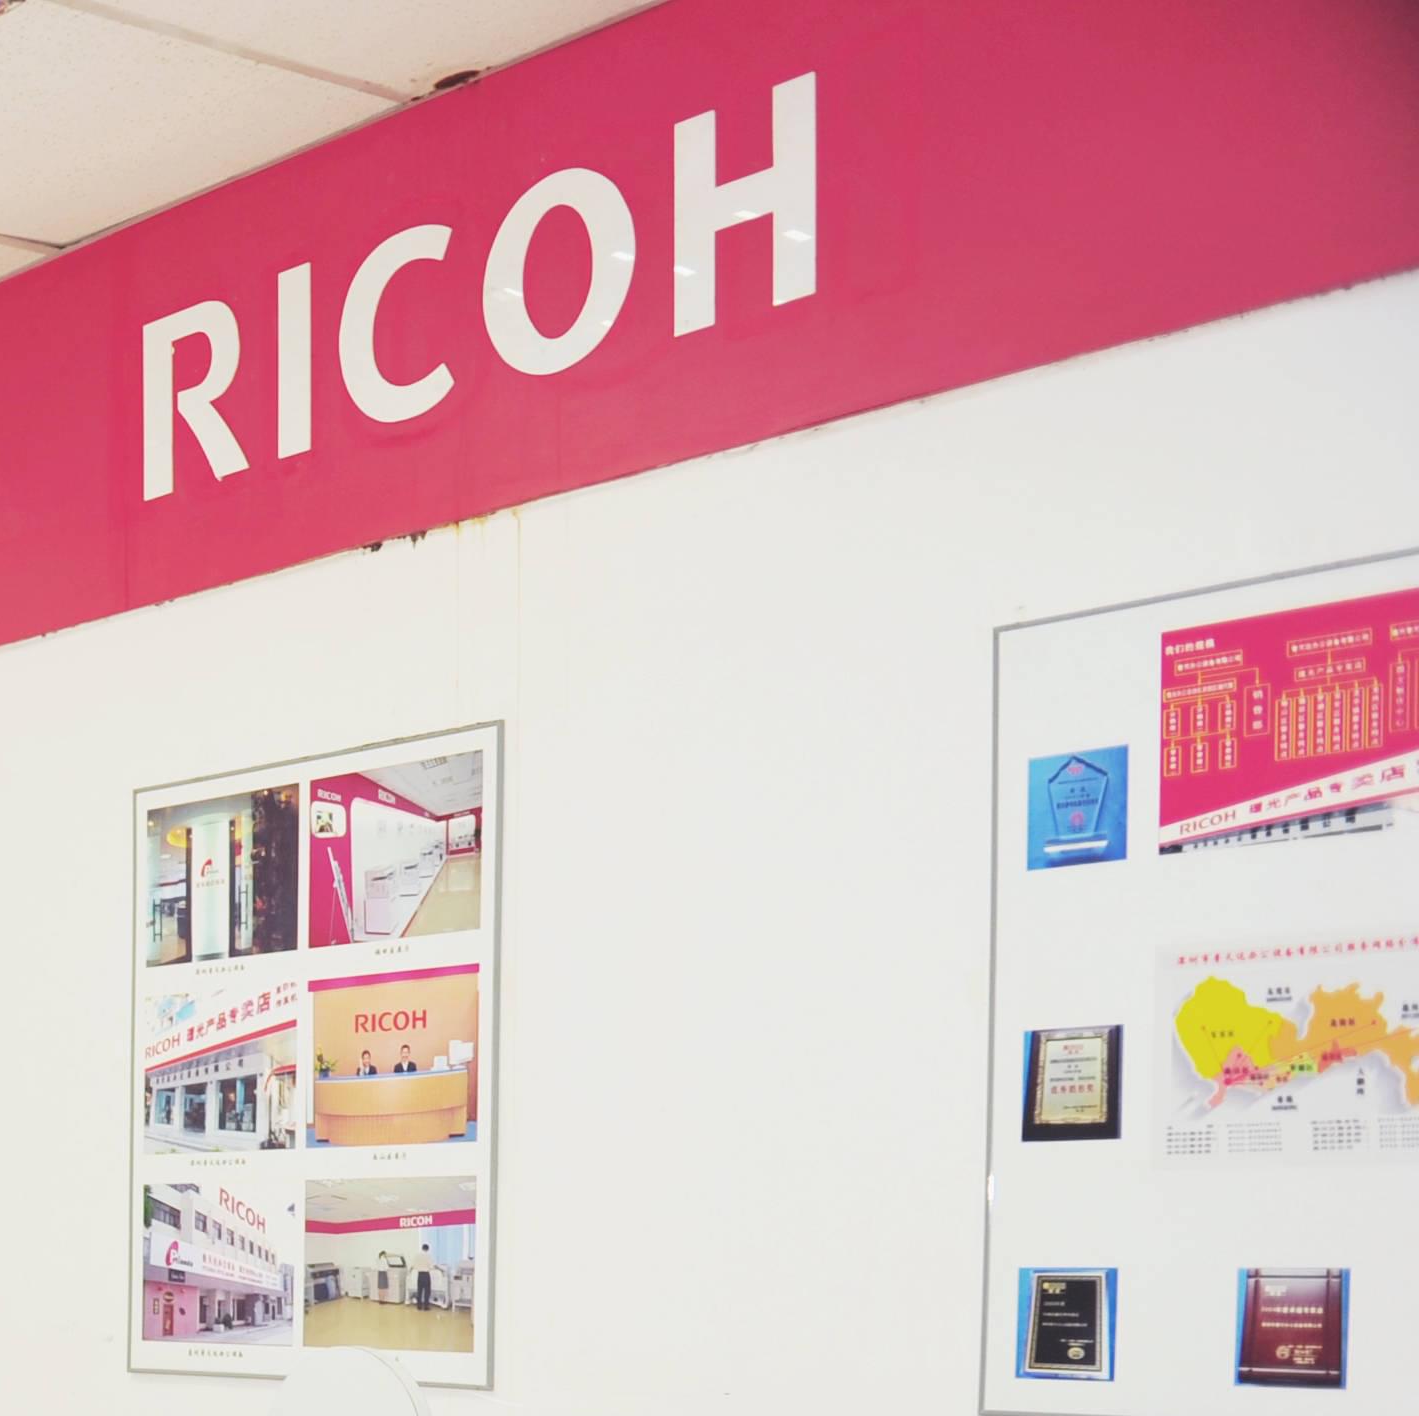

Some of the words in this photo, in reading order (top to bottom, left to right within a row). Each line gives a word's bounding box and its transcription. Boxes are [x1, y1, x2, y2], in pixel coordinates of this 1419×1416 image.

[142, 72, 817, 502] RICOH
[1179, 810, 1237, 836] RICOH
[354, 1009, 427, 1034] RICOH
[145, 1034, 181, 1060] RICOH
[219, 1186, 266, 1235] RICOH
[399, 1214, 433, 1228] RICOH
